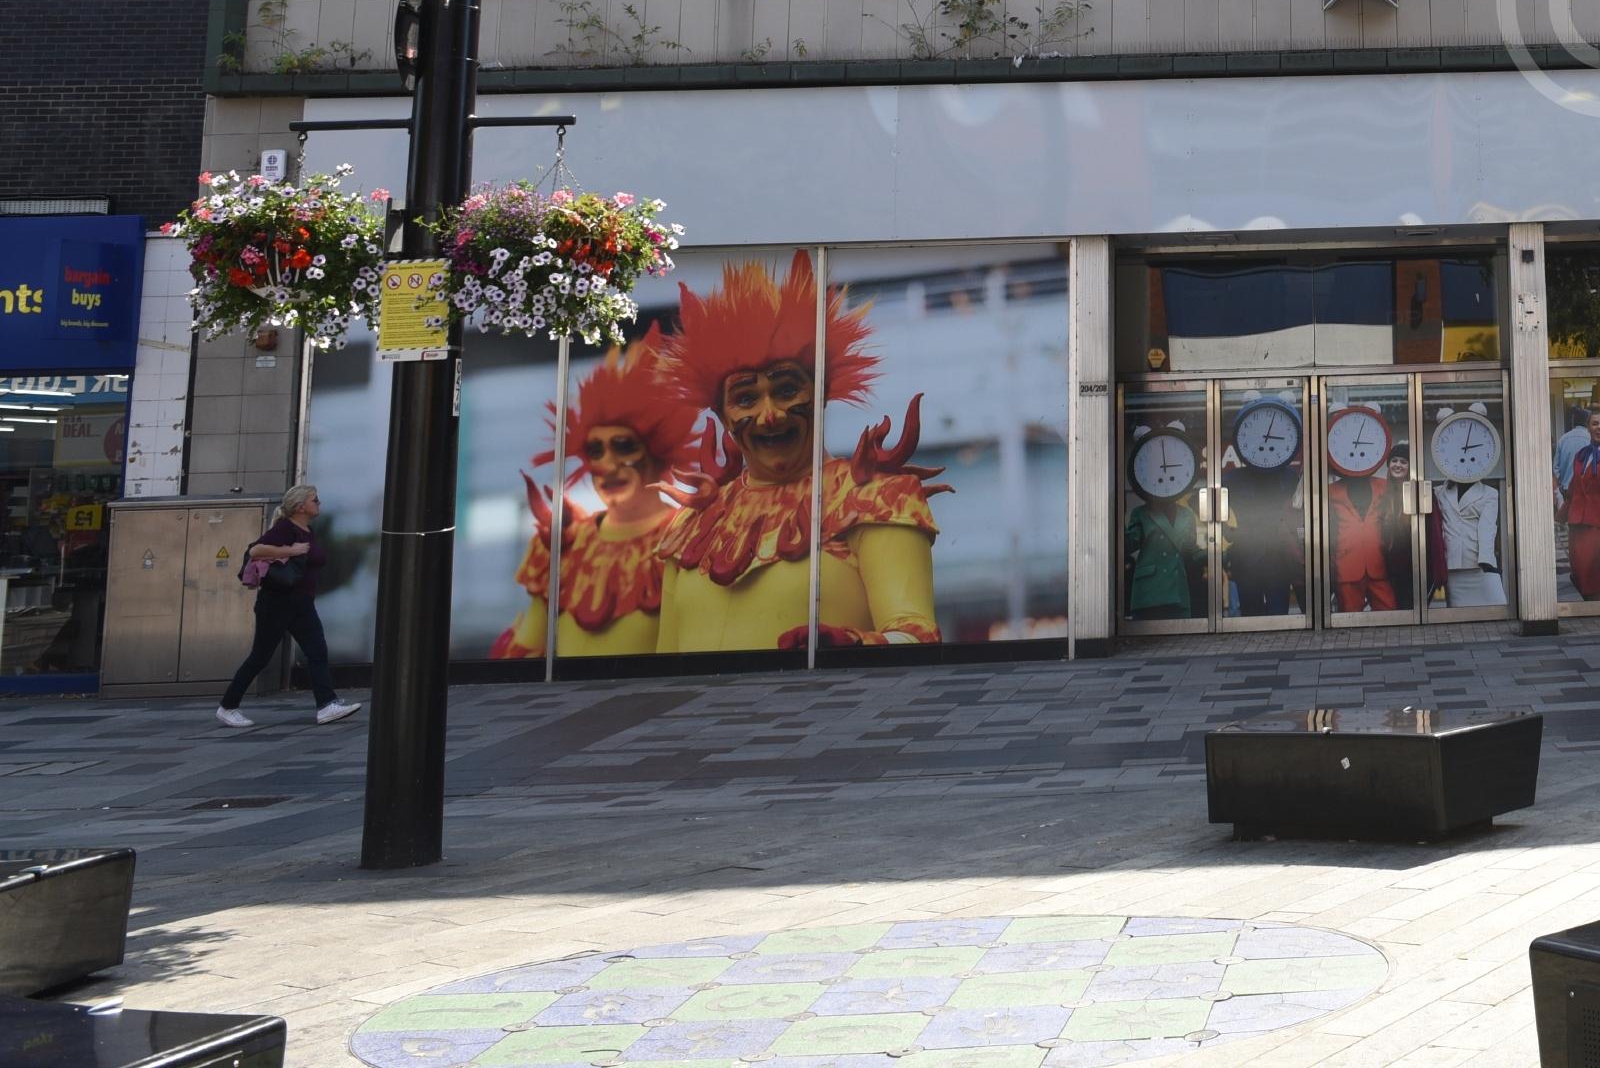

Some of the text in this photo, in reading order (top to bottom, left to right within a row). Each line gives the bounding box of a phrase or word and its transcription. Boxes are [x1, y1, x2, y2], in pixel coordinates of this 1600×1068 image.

[72, 288, 101, 310] buys
[1080, 384, 1108, 393] 204/208
[75, 511, 94, 527] £1
